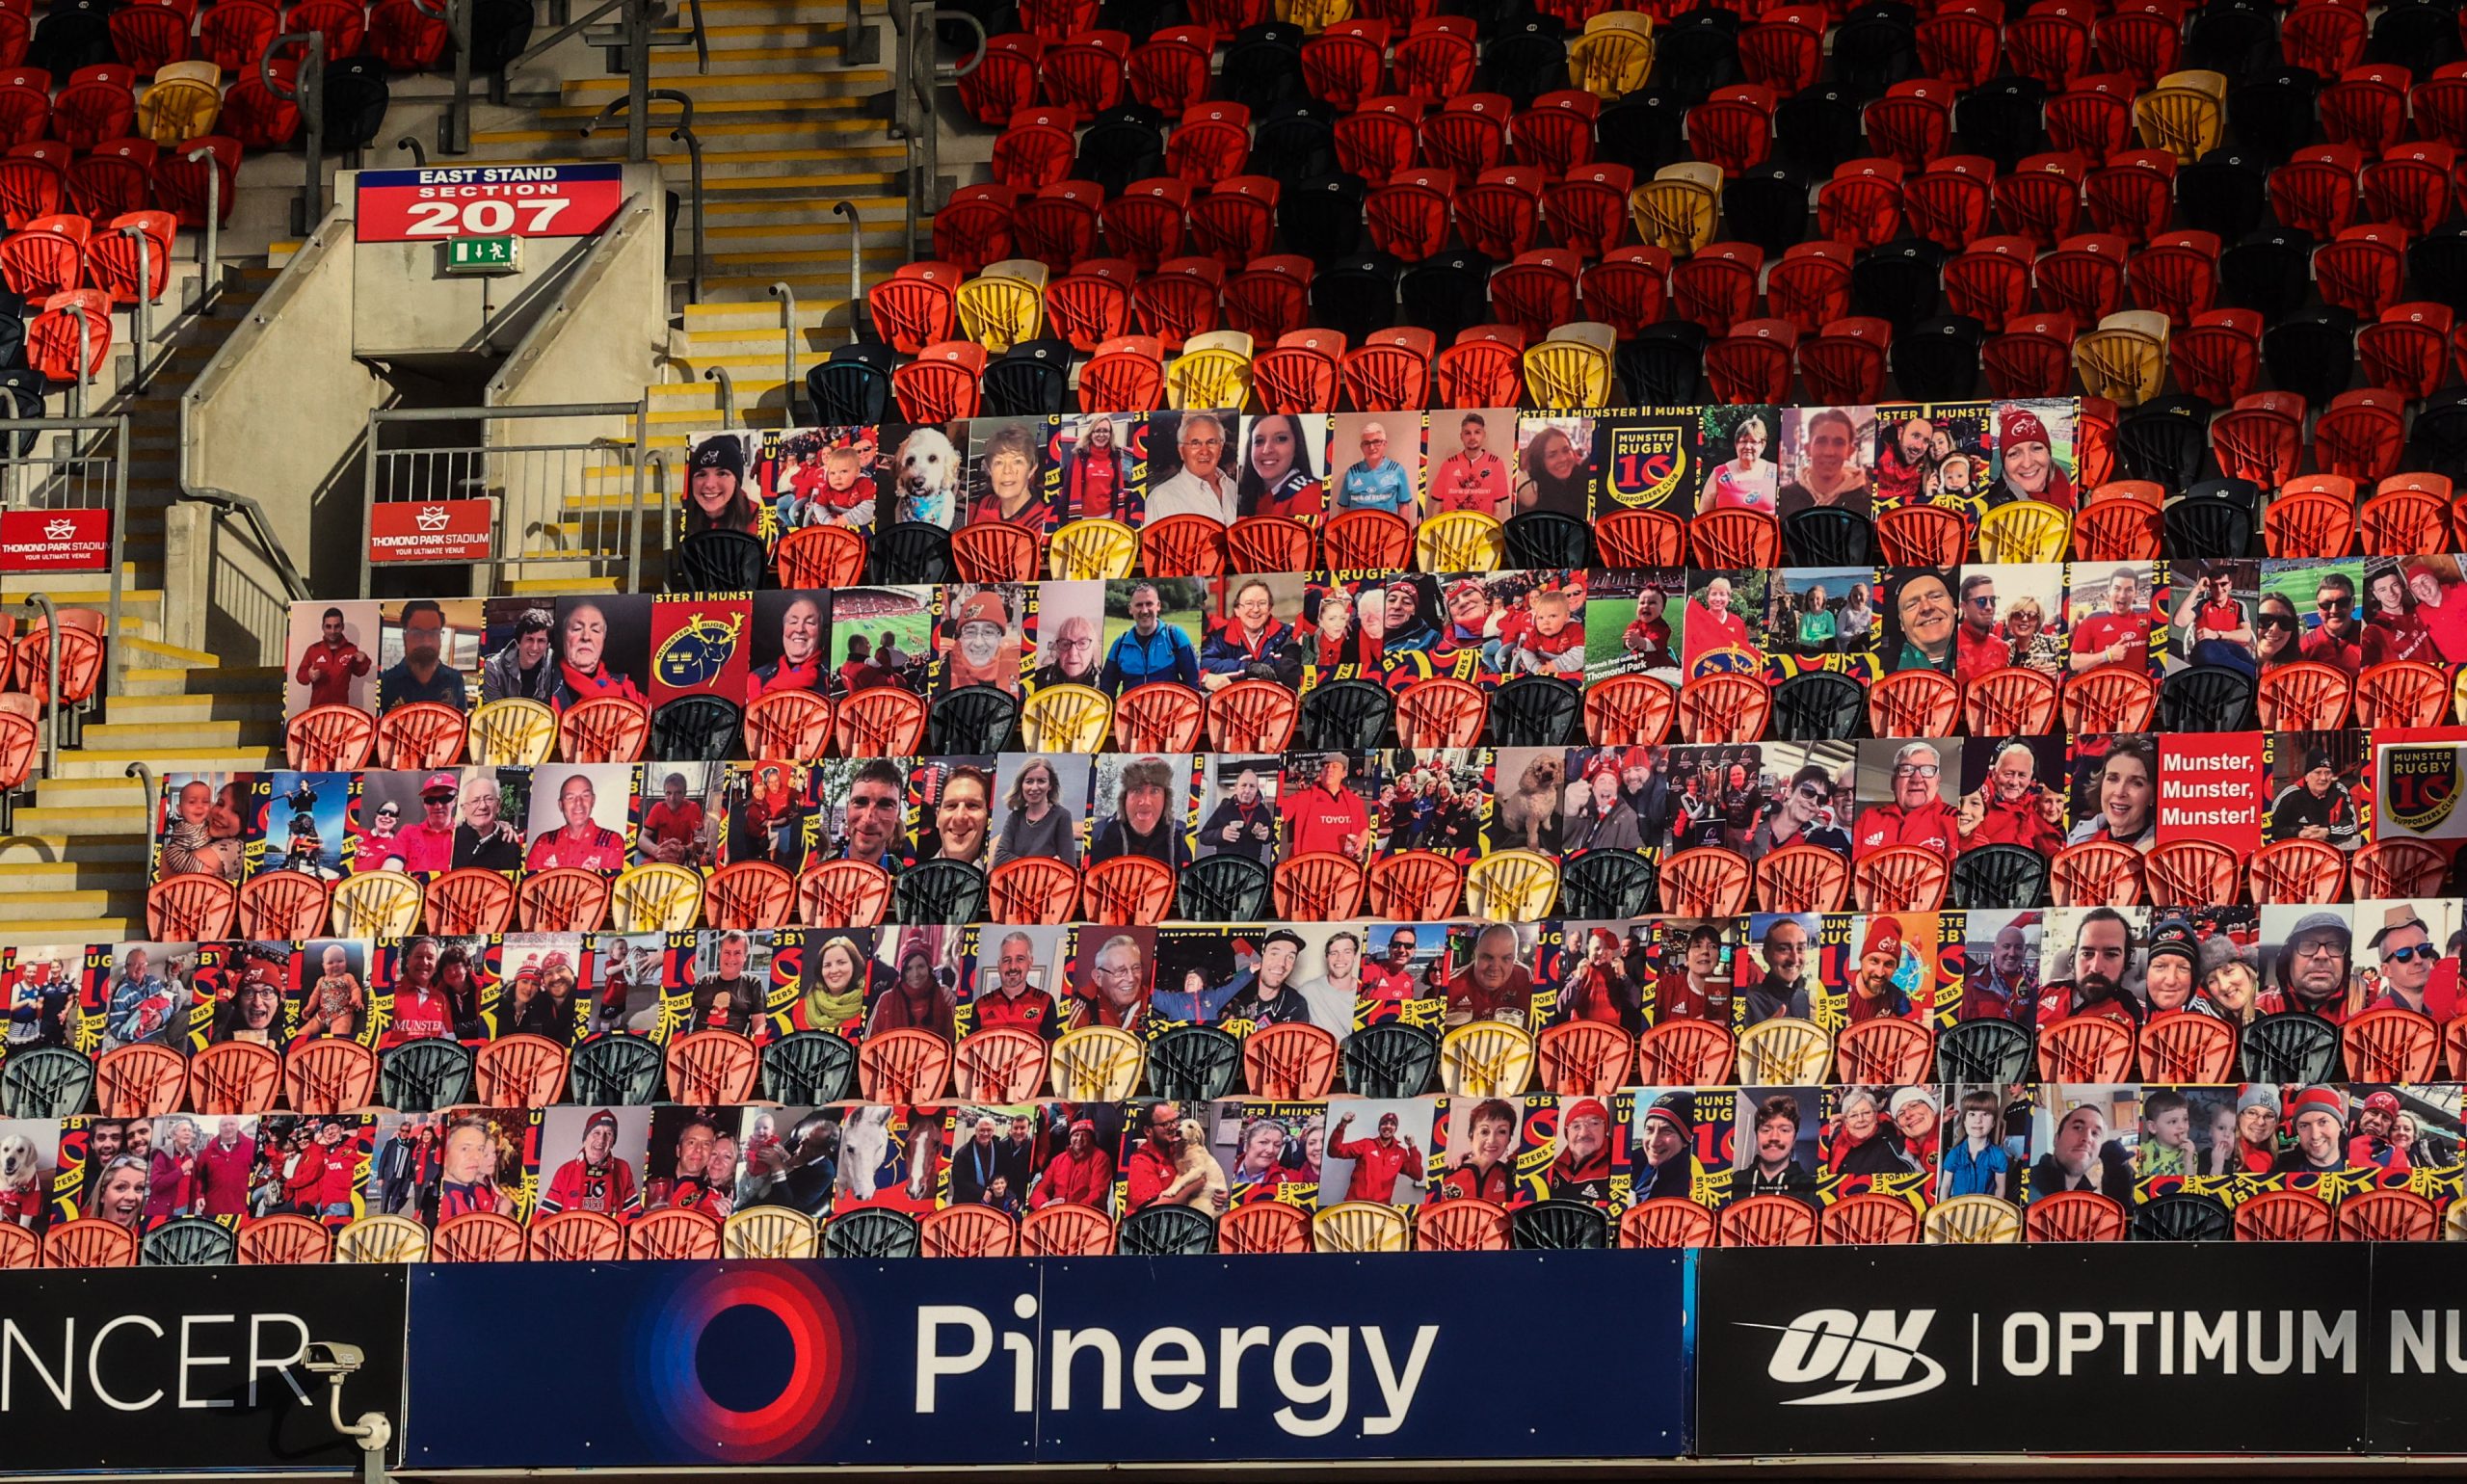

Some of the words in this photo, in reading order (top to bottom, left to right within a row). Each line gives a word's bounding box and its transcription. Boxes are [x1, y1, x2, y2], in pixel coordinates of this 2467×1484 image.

[419, 169, 478, 184] EAST
[483, 167, 557, 182] STAND
[418, 183, 558, 199] SECTION
[405, 198, 570, 236] 207
[1572, 407, 1637, 418] MUNSTER
[1619, 433, 1675, 442] MUNSTER
[1618, 442, 1674, 455] RUGBY
[1617, 455, 1673, 488] 16
[1615, 487, 1662, 503] SUPPORTERS
[1661, 473, 1680, 490] CLUB
[2, 543, 46, 553] THOMOND
[47, 542, 71, 551] PARK
[372, 536, 419, 547] THOMOND
[419, 534, 445, 545] PARK
[445, 533, 490, 544] STADIUM
[395, 547, 412, 556] YOUR
[701, 622, 730, 631] RUGBY
[656, 627, 690, 660] MUNSTER
[1586, 664, 1627, 682] Thomond
[1627, 659, 1647, 673] Park
[2162, 753, 2255, 773] Munster,
[2393, 752, 2452, 761] MUNSTER
[2393, 762, 2451, 775] RUGBY
[2162, 780, 2254, 800] Munster,
[2162, 806, 2256, 826] Munster!
[2393, 809, 2442, 826] SUPPORTERS
[2441, 793, 2458, 811] CLUB
[392, 1020, 443, 1032] MUNSTER
[583, 1179, 606, 1198] 16
[1767, 1308, 1937, 1383] ON
[2002, 1309, 2358, 1376] OPTIMUM
[0, 1312, 313, 1412] NCER
[915, 1292, 1441, 1438] Pinergy
